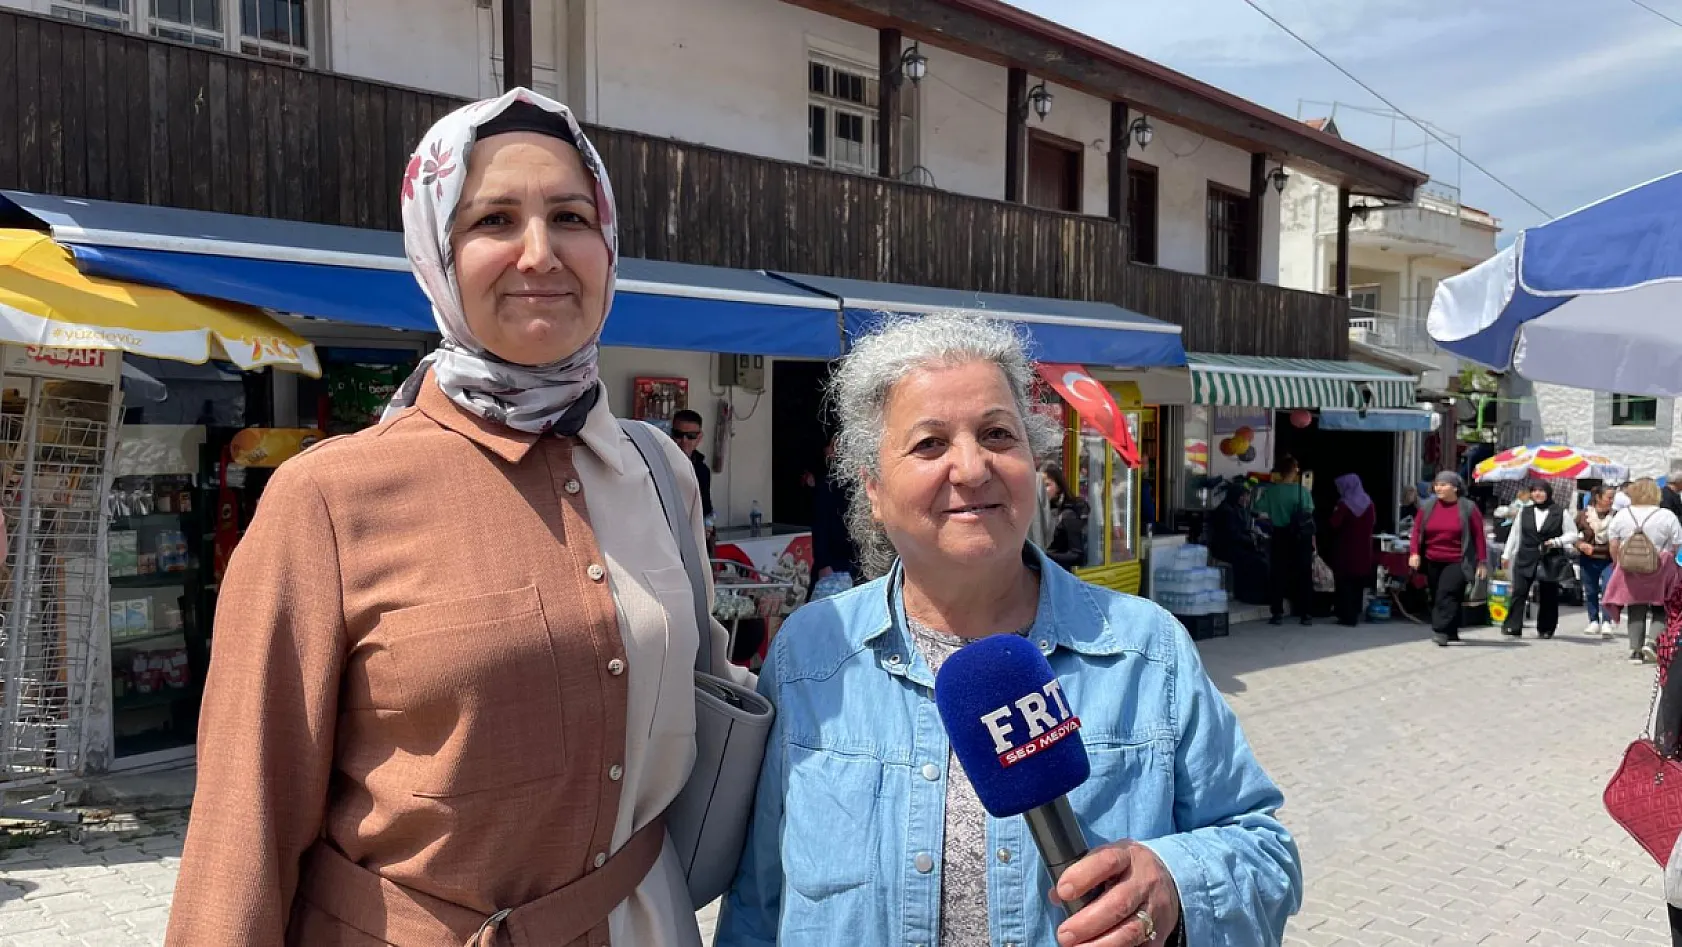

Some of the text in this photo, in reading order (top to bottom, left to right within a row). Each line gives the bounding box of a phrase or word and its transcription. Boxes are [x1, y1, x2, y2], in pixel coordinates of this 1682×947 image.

[980, 679, 1070, 755] FRT
[1006, 721, 1080, 764] SED MEDYA
